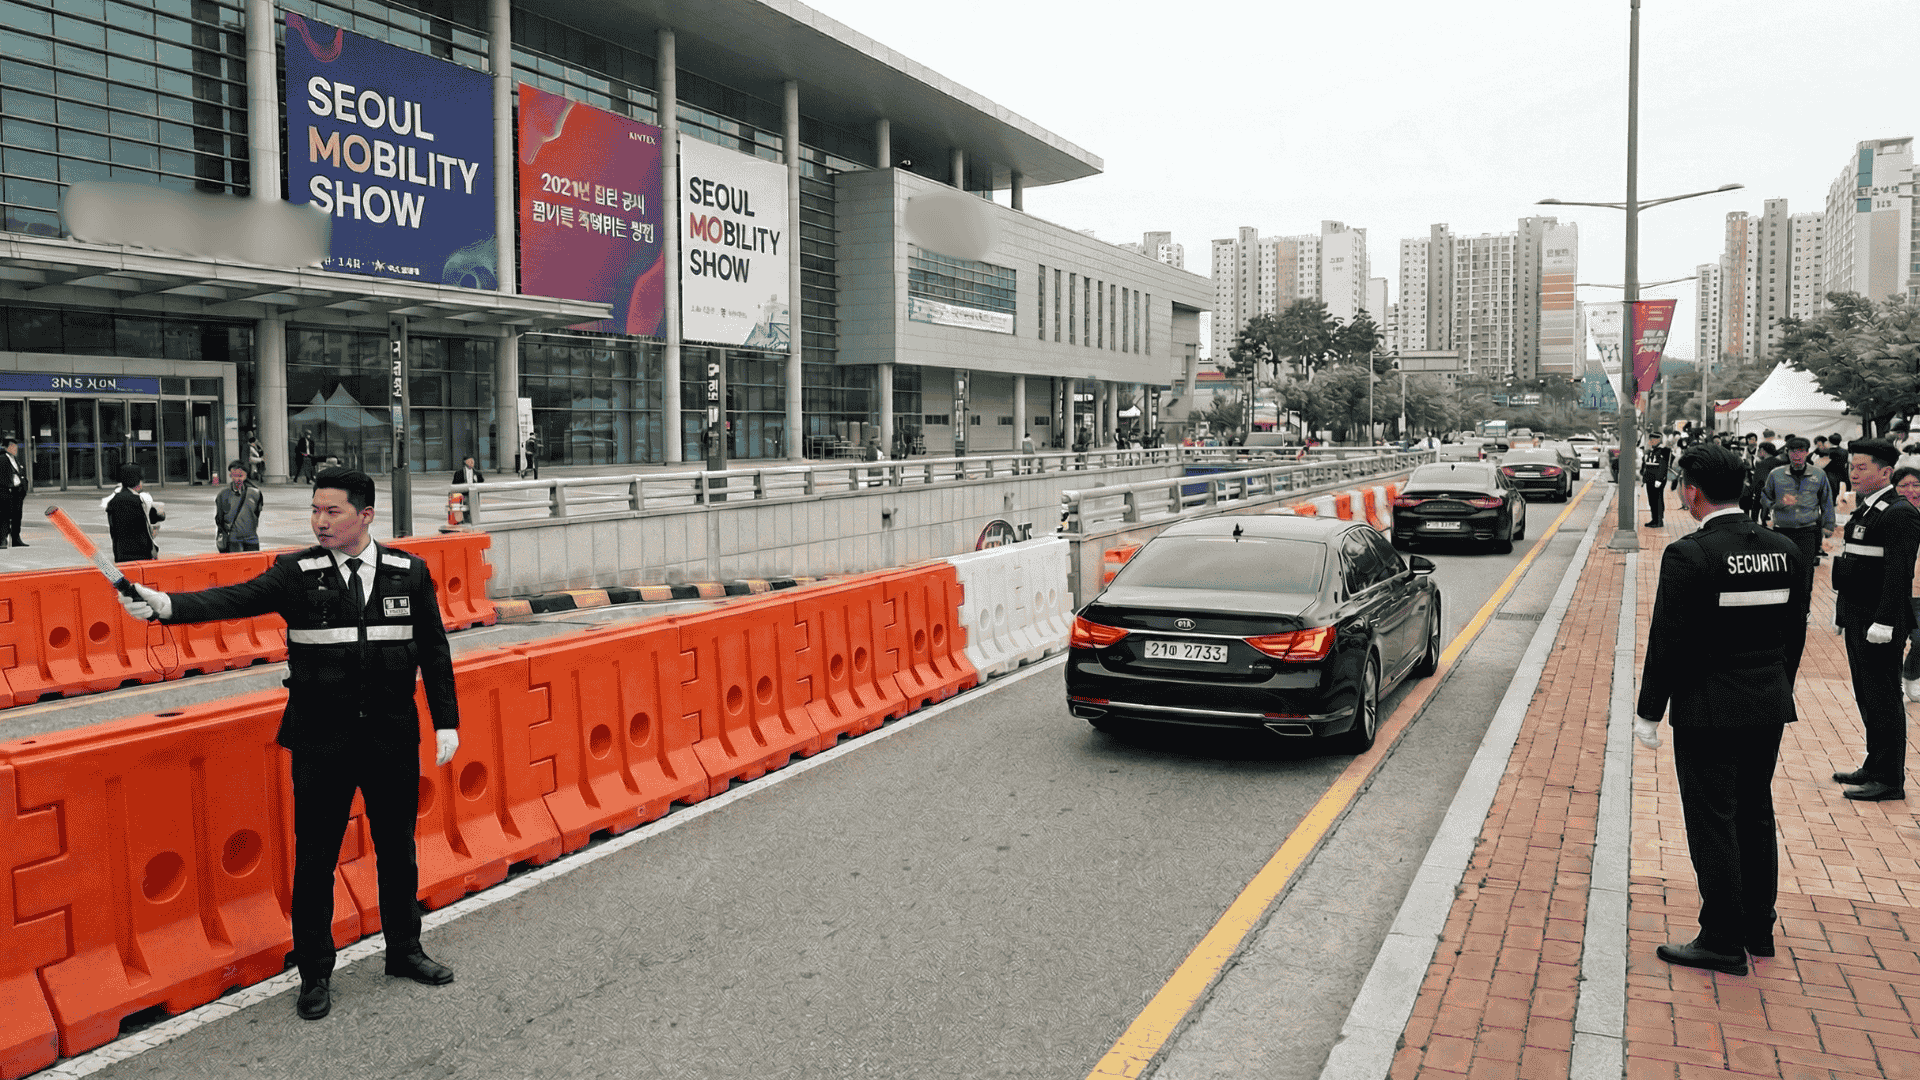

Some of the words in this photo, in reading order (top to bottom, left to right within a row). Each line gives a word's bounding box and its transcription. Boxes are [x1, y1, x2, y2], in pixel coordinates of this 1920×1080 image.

[307, 76, 434, 141] SEOUL
[308, 125, 479, 195] MOBILITY
[309, 175, 425, 229] SHOW
[689, 176, 755, 217] SEOUL
[690, 212, 781, 256] MOBILITY
[690, 249, 750, 283] SHOW
[1727, 553, 1788, 575] SECURITY
[1183, 643, 1222, 661] 2733
